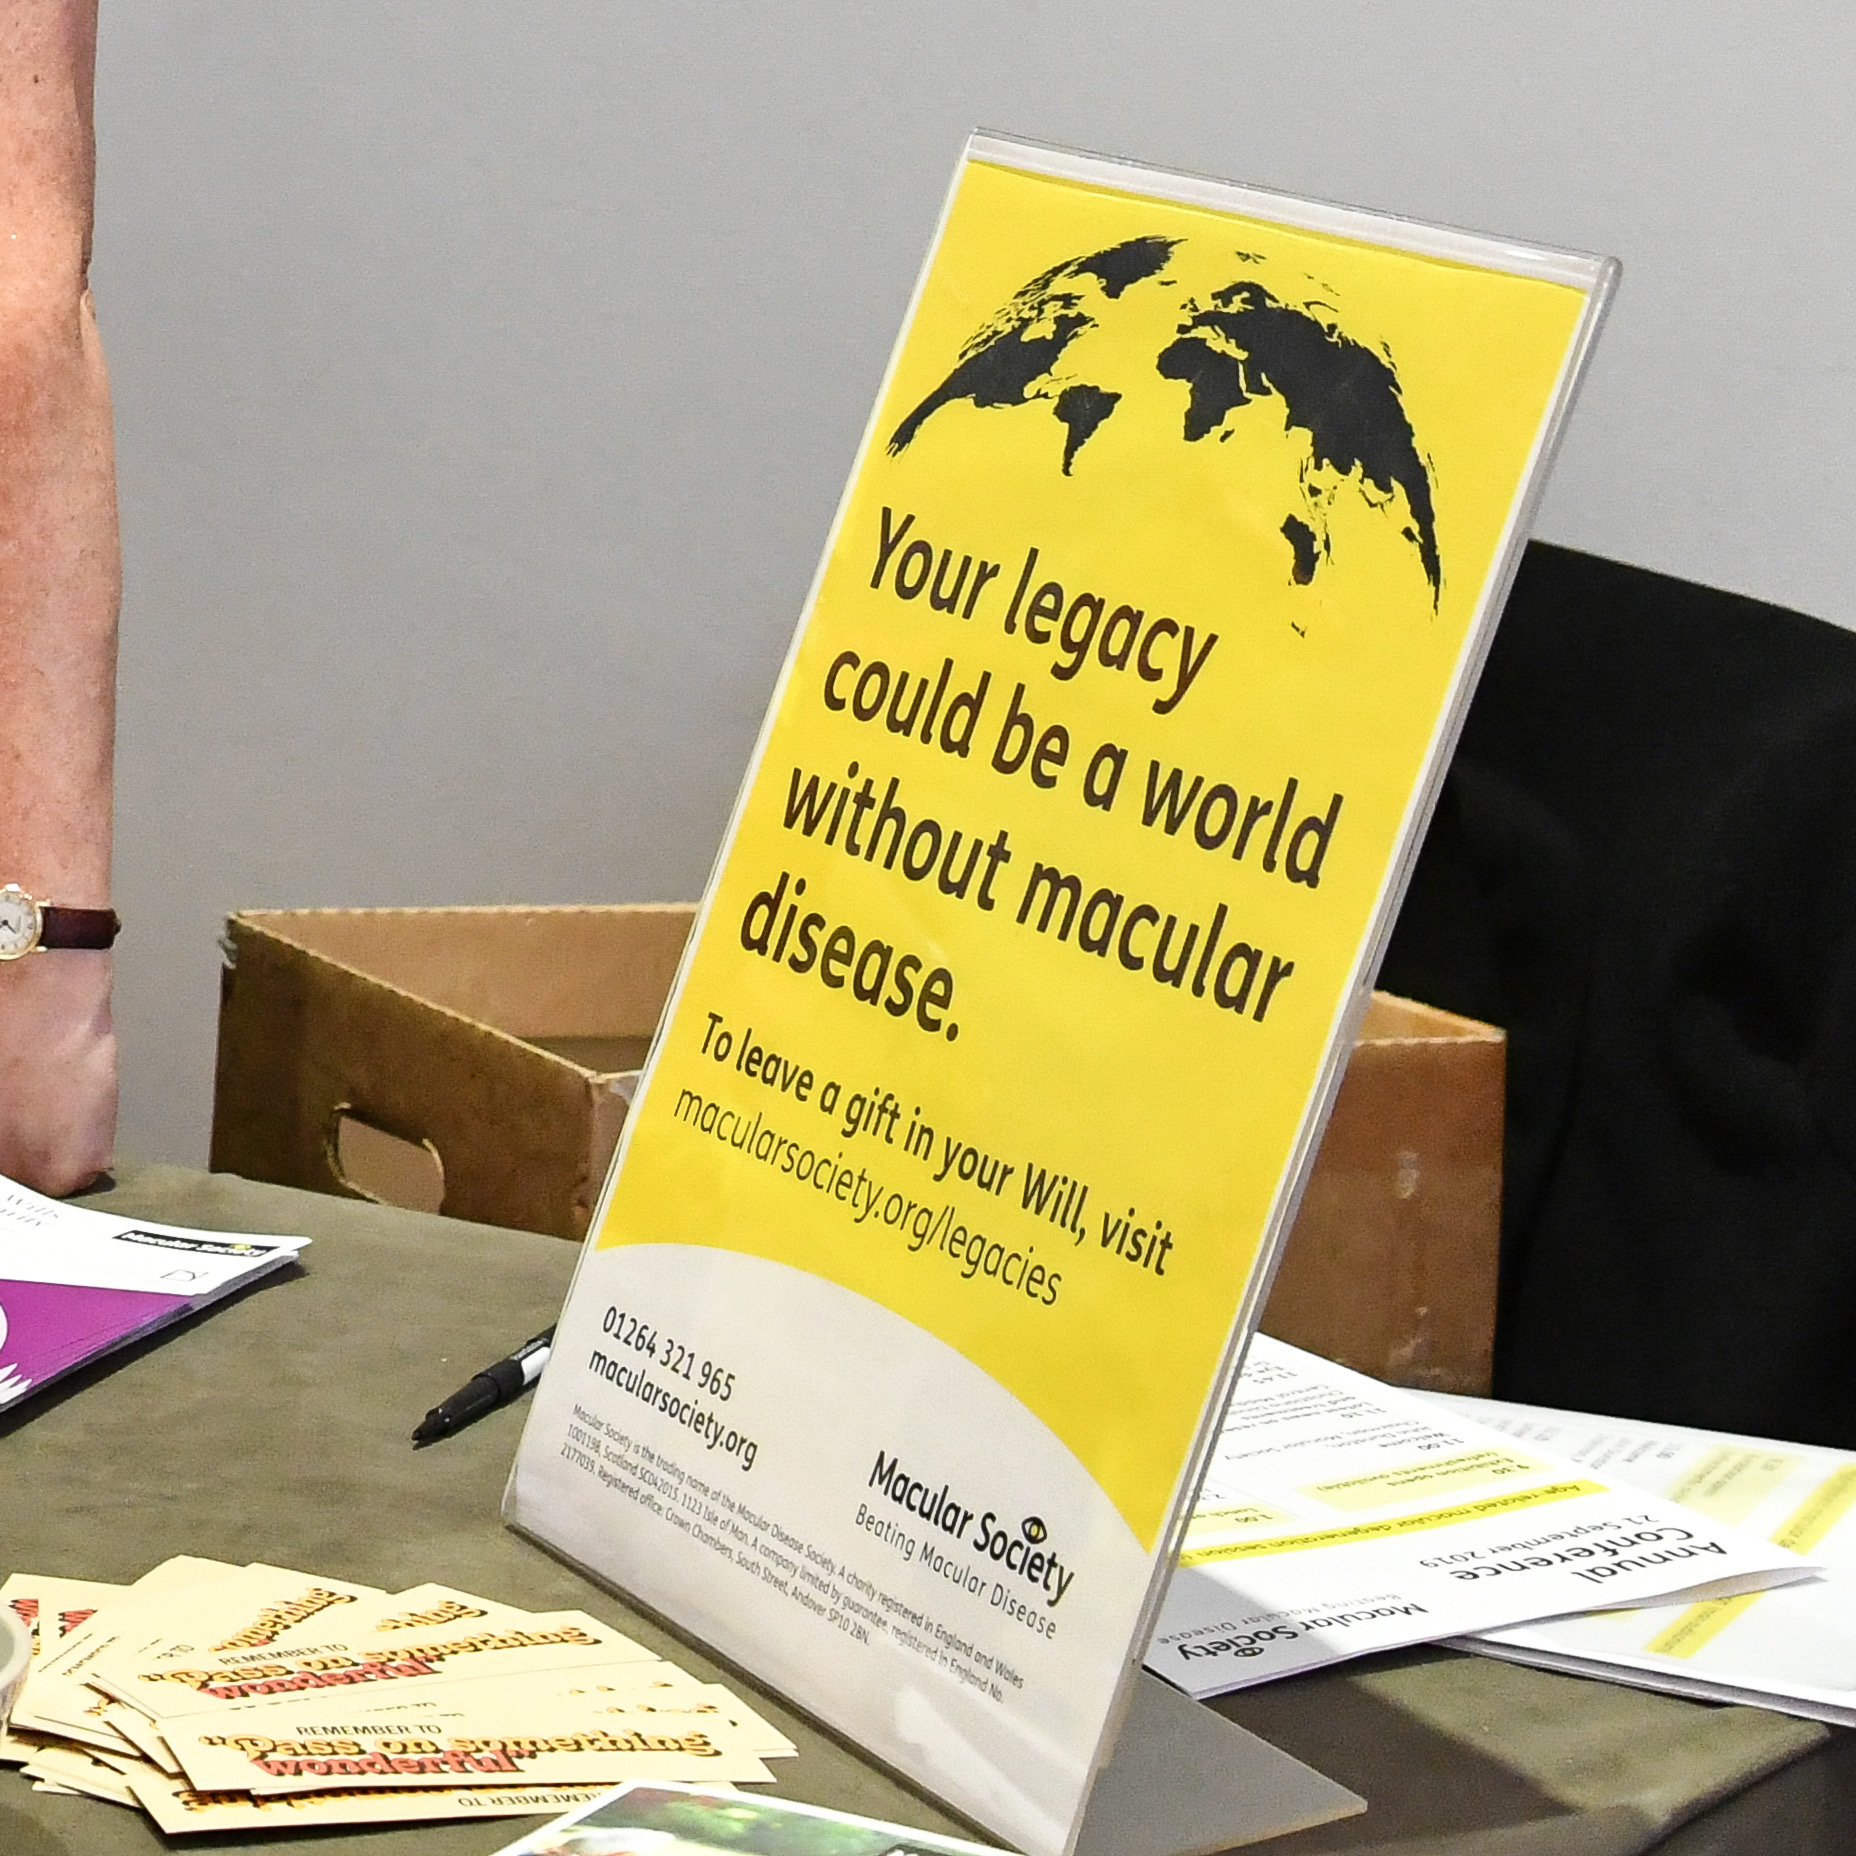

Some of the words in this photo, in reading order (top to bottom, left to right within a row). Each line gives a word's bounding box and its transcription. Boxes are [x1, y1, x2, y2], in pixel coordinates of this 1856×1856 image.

[868, 505, 1001, 621] Your
[1003, 546, 1220, 716] legacy
[822, 649, 993, 759] could
[990, 681, 1070, 790] be
[1082, 742, 1129, 813] a
[1140, 758, 1345, 890] world
[782, 766, 1012, 912] without
[1014, 861, 1295, 1023] macular
[739, 870, 959, 1043] disease.
[700, 1010, 733, 1063] To
[734, 1026, 814, 1103] leave
[818, 1080, 842, 1116] a
[839, 1086, 901, 1145] gift
[902, 1105, 935, 1162] in
[931, 1135, 1015, 1197] your
[1020, 1161, 1089, 1247] Will,
[1099, 1206, 1174, 1277] visit
[672, 1087, 1063, 1306] macularsociety.org/legacies
[601, 1305, 658, 1359] 01264
[658, 1337, 696, 1382] 321
[696, 1360, 736, 1402] 965
[587, 1349, 759, 1473] macularsociety.org
[867, 1449, 975, 1540] Macular
[971, 1511, 1075, 1607] Society
[1487, 1521, 1622, 1554] September
[1621, 1513, 1659, 1526] 21
[854, 1502, 916, 1562] Beating
[917, 1540, 988, 1597] Macular
[989, 1581, 1057, 1640] Disease
[1417, 1549, 1481, 1568] 2019
[1448, 1525, 1694, 1580] Conference
[1569, 1540, 1728, 1585] Annual
[1175, 1624, 1299, 1661] Society
[1298, 1601, 1429, 1632] Macular
[218, 1648, 320, 1666] REMEMBER
[326, 1644, 348, 1655] TO
[295, 1655, 355, 1670] on
[358, 1625, 603, 1663] something
[296, 1725, 406, 1736] REMEMBER
[411, 1725, 442, 1735] TO
[373, 1735, 443, 1755] on
[448, 1729, 723, 1757] something
